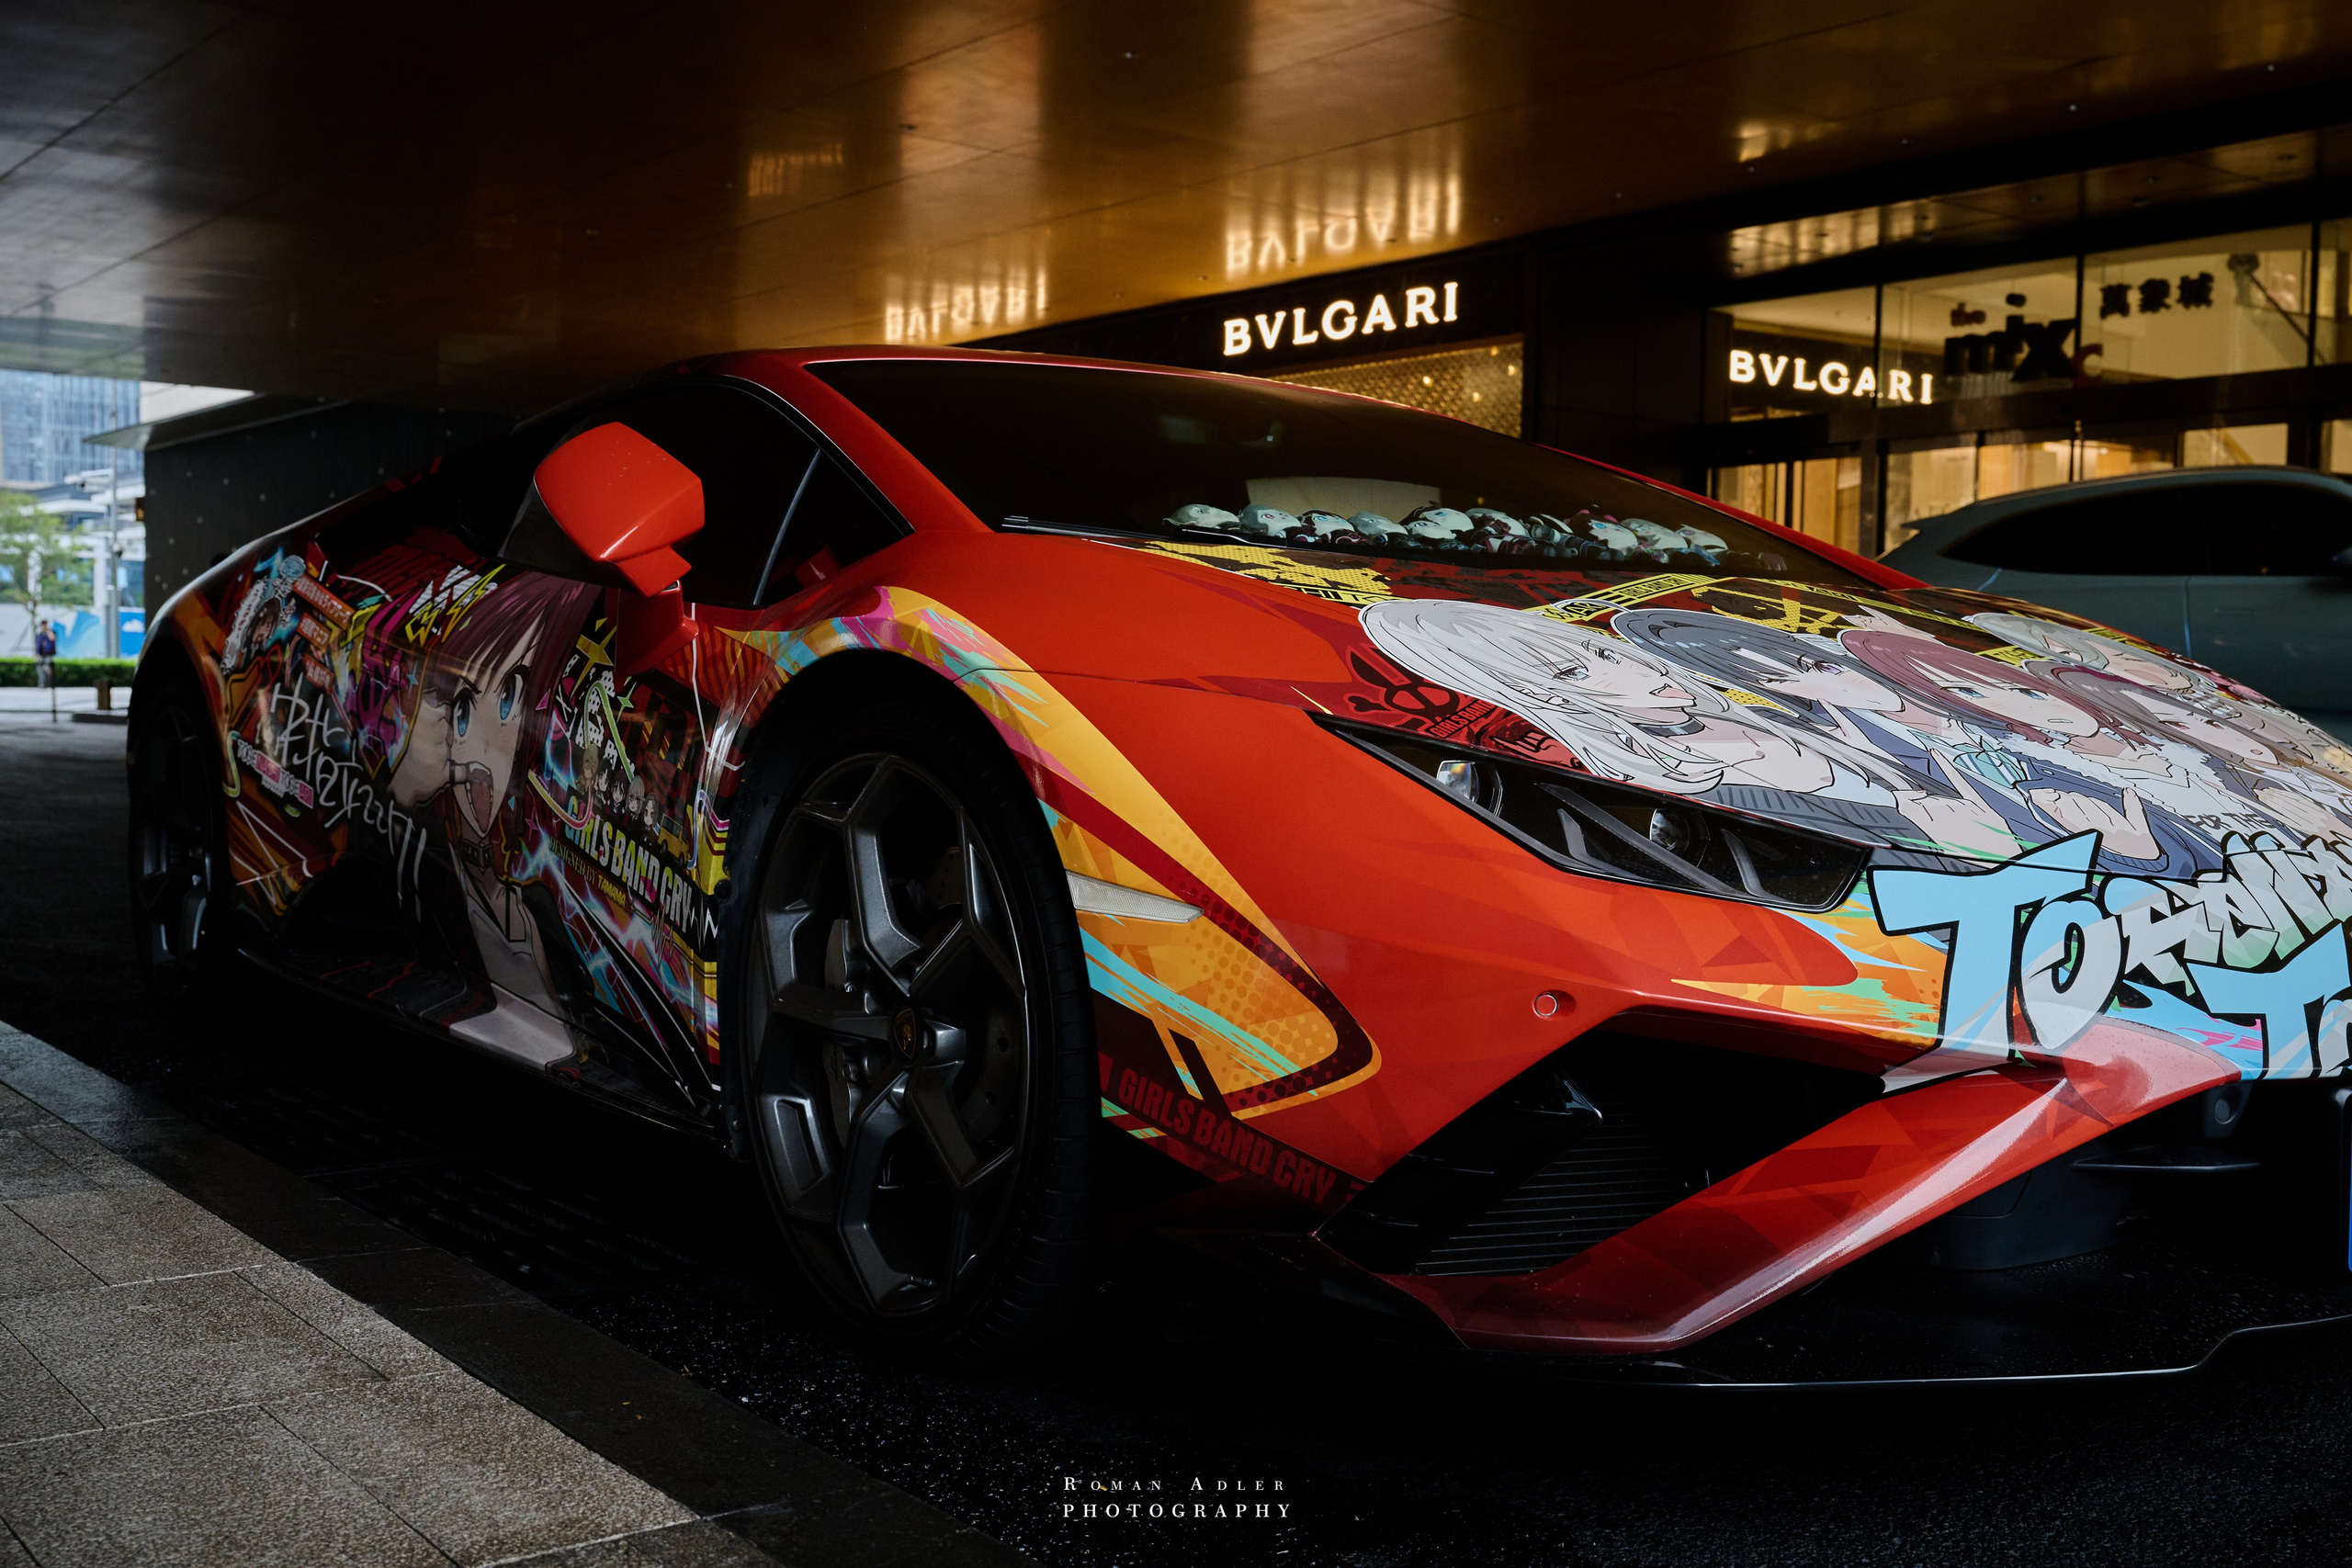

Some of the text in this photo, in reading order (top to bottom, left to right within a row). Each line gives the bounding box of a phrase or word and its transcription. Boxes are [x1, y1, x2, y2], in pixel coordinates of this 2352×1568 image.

[1223, 281, 1459, 356] BVLGARI
[1729, 349, 1933, 404] BVLGARI
[1429, 714, 1469, 738] GIRLS
[611, 829, 661, 904] BAND
[659, 865, 693, 934] CRY
[1118, 1066, 1338, 1205] GIRLS BAND CRY
